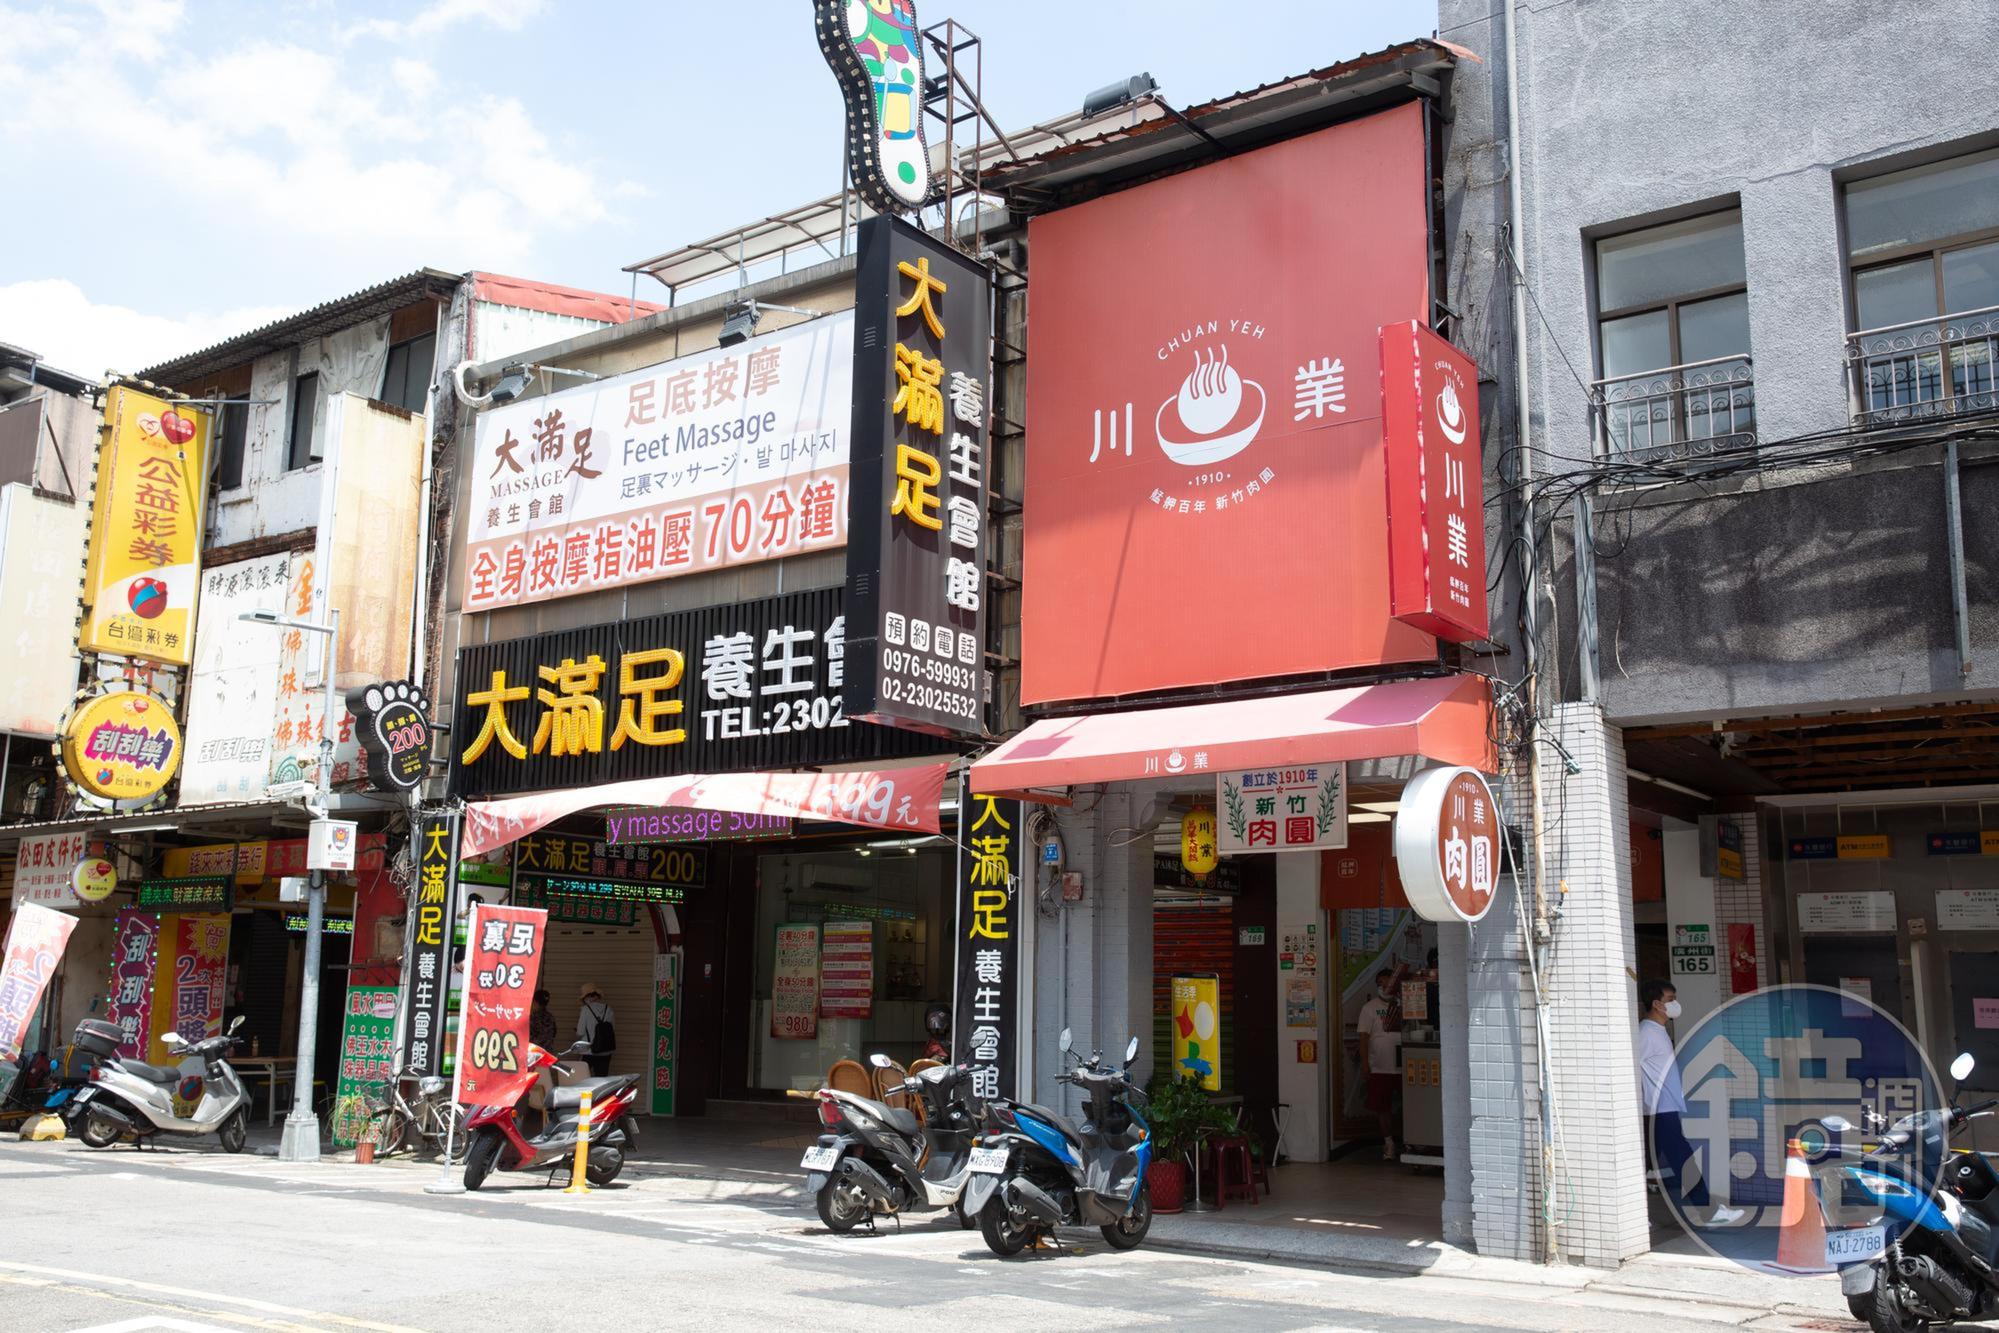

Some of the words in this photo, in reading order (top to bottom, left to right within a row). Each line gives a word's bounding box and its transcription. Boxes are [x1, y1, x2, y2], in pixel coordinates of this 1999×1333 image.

[1157, 320, 1219, 360] CHUAN
[1228, 319, 1266, 340] YEH
[624, 346, 782, 429] 足底按摩
[891, 257, 948, 530] 大滿足
[1089, 402, 1132, 462] 川
[1294, 357, 1346, 421] 業
[489, 409, 602, 480] 大滿足
[623, 433, 669, 466] Feet
[675, 408, 776, 454] Massage
[757, 447, 774, 470] 발
[780, 429, 838, 463] 마사지
[490, 469, 563, 500] MASSAGE
[945, 371, 983, 613] 養生會館
[1148, 487, 1206, 514] 艋舺百年
[1215, 466, 1276, 511] 新竹肉圓
[129, 456, 181, 567] 公益彩券
[487, 493, 565, 528] 養生會館
[1445, 452, 1468, 568] 川業
[471, 511, 692, 602] 全身按摩指油壓
[705, 480, 836, 558] 70分鐘
[108, 622, 179, 648] 台灣彩券
[885, 611, 977, 665] 預約電話
[883, 647, 977, 691] 0976-599931
[462, 649, 688, 766] 大滿足
[701, 696, 850, 741] TEL:2302
[882, 676, 977, 719] 02-23025532
[94, 730, 165, 763] 刮刮樂
[389, 722, 426, 754] 200
[1145, 757, 1158, 773] 川
[1193, 751, 1208, 769] 業
[1241, 768, 1318, 788] 創立於1910年
[628, 811, 722, 840] massage
[1255, 795, 1306, 816] 新竹
[1249, 816, 1315, 847] 肉圓
[518, 837, 590, 873] 大滿足
[651, 848, 695, 882] 200
[969, 794, 1010, 940] 大滿足
[1445, 826, 1493, 897] 肉圓
[415, 823, 449, 946] 大滿足
[1688, 933, 1707, 944] 165
[1677, 957, 1710, 973] 165
[119, 934, 149, 1045] 刮刮樂
[410, 951, 437, 1070] 養生會館
[785, 1015, 809, 1032] 980
[971, 949, 1002, 1099] 養生會館
[1828, 1230, 1882, 1256] NAJ-2788
